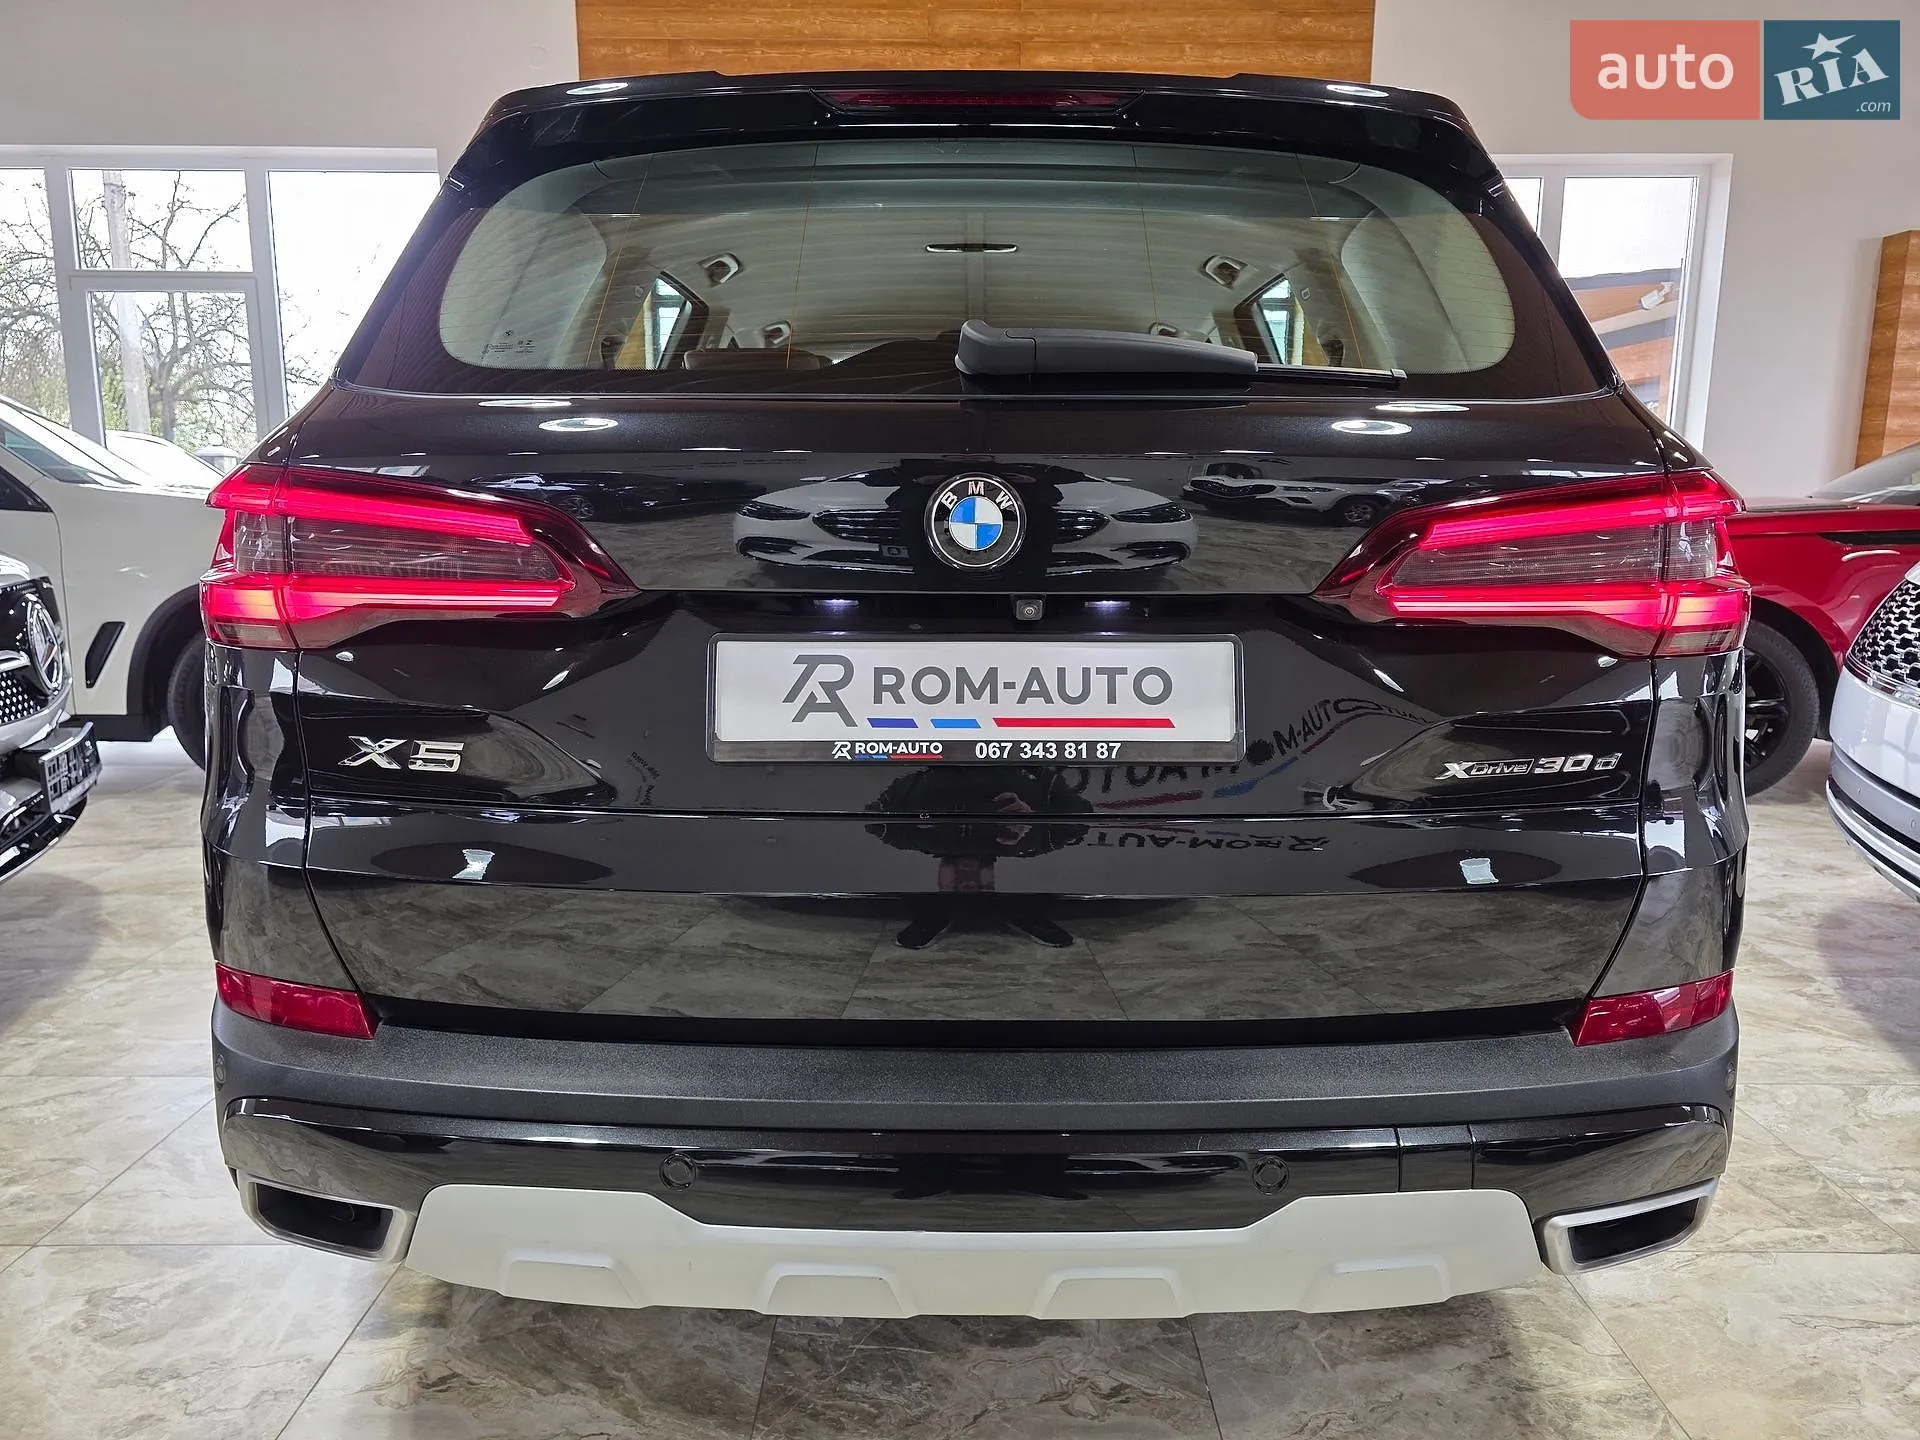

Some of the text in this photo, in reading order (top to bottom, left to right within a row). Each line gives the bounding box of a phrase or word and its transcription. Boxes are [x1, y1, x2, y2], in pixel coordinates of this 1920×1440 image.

[940, 480, 1015, 510] BMW
[873, 666, 1174, 706] ROM-AUTO
[338, 735, 465, 773] X5
[854, 741, 943, 755] ROM-AUTO
[975, 742, 1122, 760] 067 343 81 87
